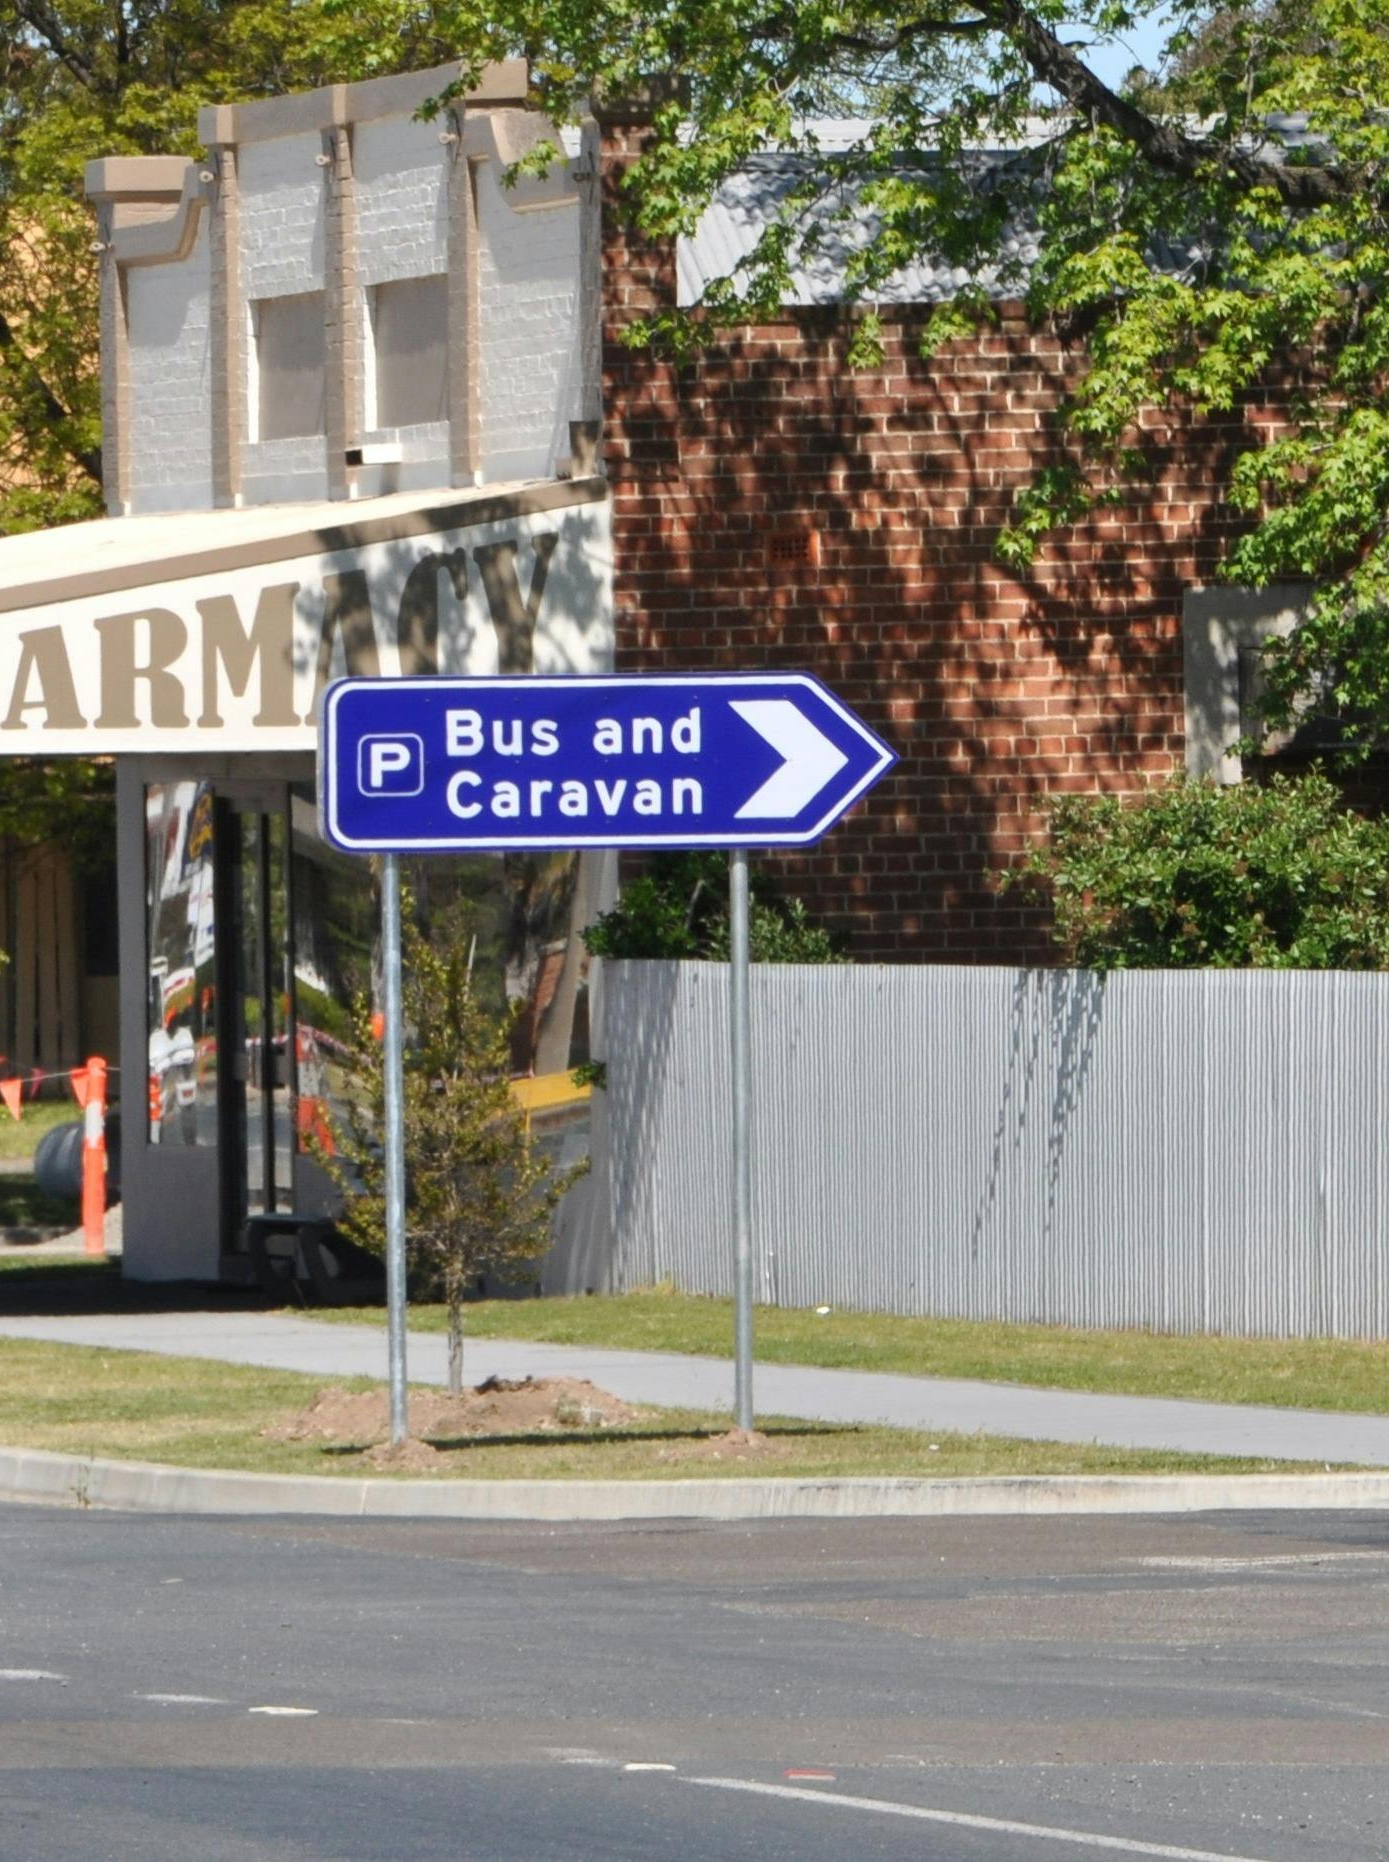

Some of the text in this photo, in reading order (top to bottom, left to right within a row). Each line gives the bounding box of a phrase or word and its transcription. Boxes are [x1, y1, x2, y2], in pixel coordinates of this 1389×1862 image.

[445, 707, 702, 757] Bus and
[369, 743, 411, 788] P
[446, 771, 704, 819] Caravan
